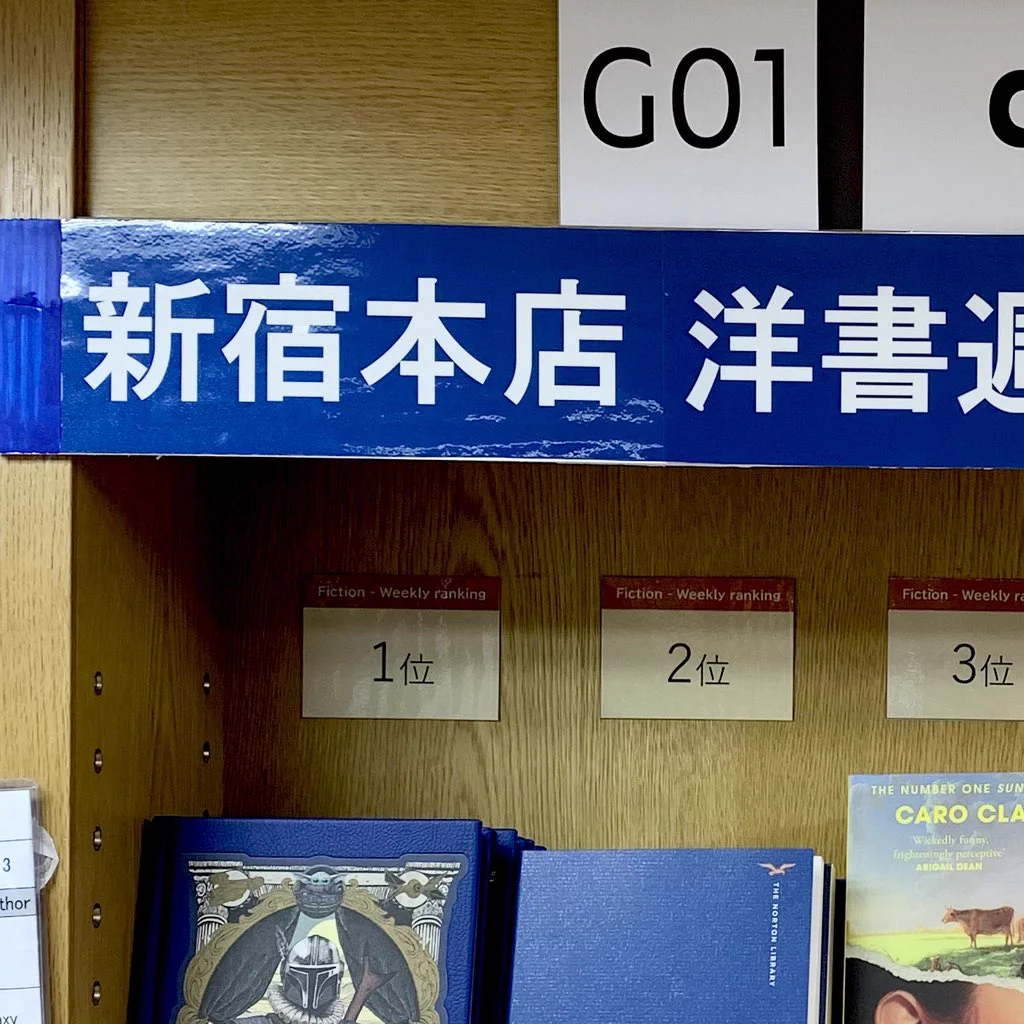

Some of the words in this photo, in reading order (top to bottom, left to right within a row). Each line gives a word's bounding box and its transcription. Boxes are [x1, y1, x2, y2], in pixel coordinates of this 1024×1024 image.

[582, 46, 787, 149] G01
[82, 271, 627, 407] 新宿本店
[317, 586, 365, 599] Fiction
[379, 586, 429, 602] Weekly
[434, 587, 486, 603] ranking
[616, 586, 663, 600] Fiction
[676, 587, 726, 604] Weekly
[730, 588, 781, 605] ranking
[903, 587, 950, 600] Fiction
[962, 587, 1010, 604] Weekly
[372, 641, 435, 685] 1位
[667, 642, 730, 687] 2位
[952, 642, 1014, 687] 3位
[872, 785, 894, 795] THE
[901, 784, 956, 795] NUMBER
[962, 783, 990, 794] ONE
[895, 804, 968, 824] CARO
[916, 862, 952, 872] ABIGAIL
[957, 862, 983, 871] DEAN
[770, 904, 779, 942] NORTON
[768, 946, 777, 987] LIBRARY
